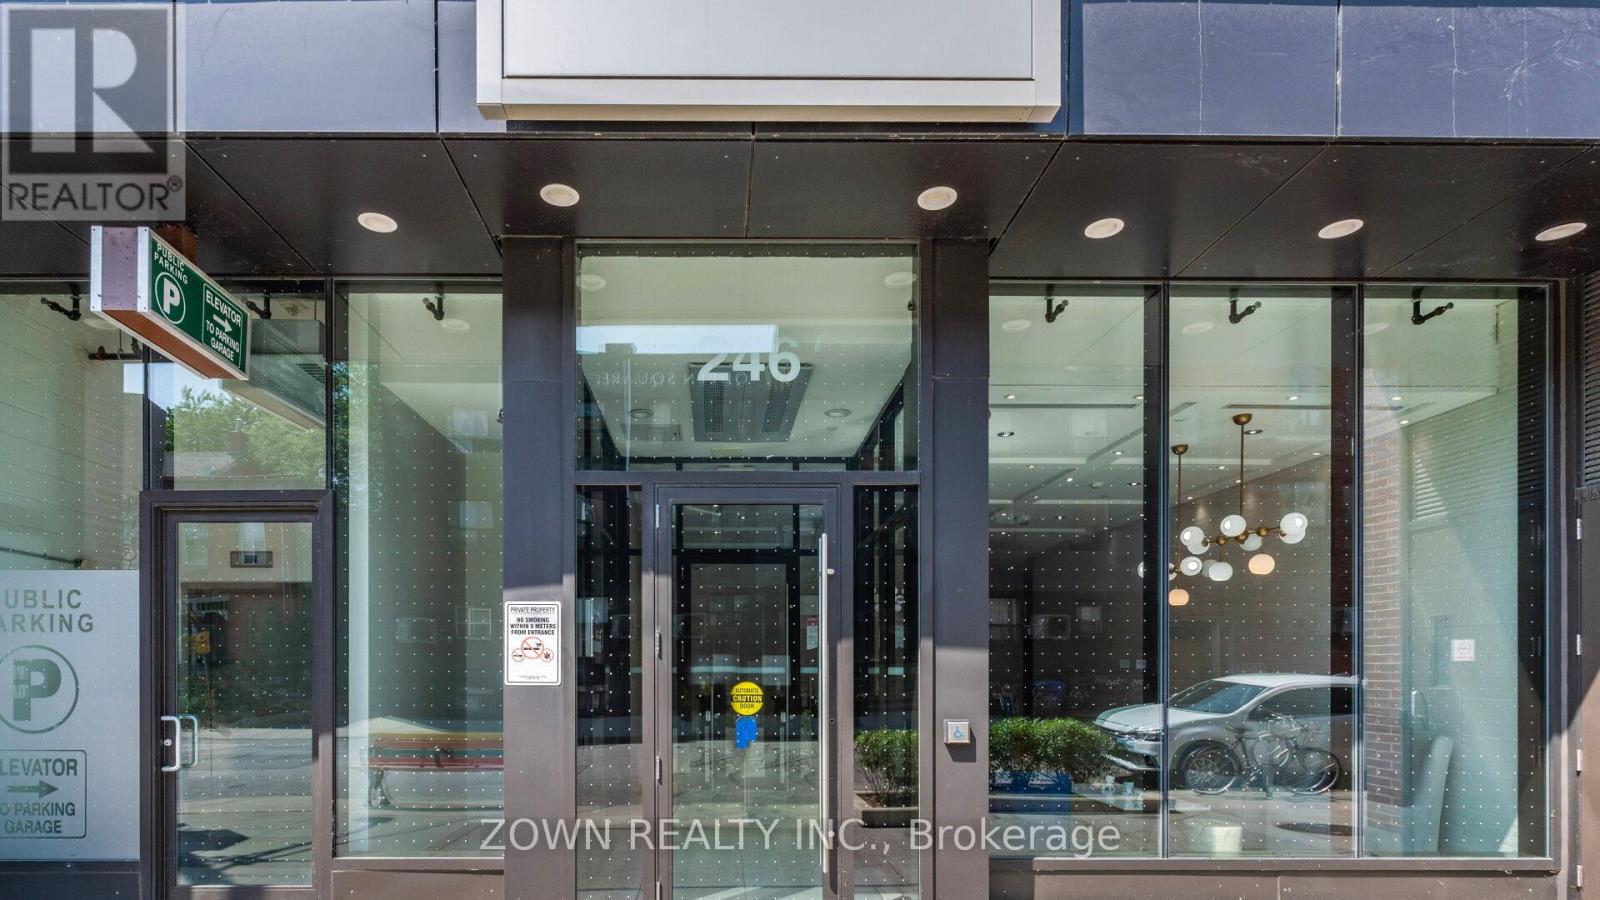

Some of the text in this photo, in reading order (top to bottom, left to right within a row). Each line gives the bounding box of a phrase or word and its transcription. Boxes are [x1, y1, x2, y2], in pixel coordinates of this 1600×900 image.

[154, 254, 188, 285] PARKING
[157, 243, 185, 271] PUBLIC
[163, 278, 181, 314] P
[205, 290, 242, 327] ELEVATOR
[206, 320, 240, 352] TO PARKING
[210, 337, 235, 361] GARAGE
[697, 336, 801, 382] 246
[4, 589, 82, 609] UBLIC
[13, 659, 62, 721] P
[0, 758, 78, 777] LEVATOR
[0, 802, 76, 816] O PARKING
[5, 820, 62, 834] GARAGE
